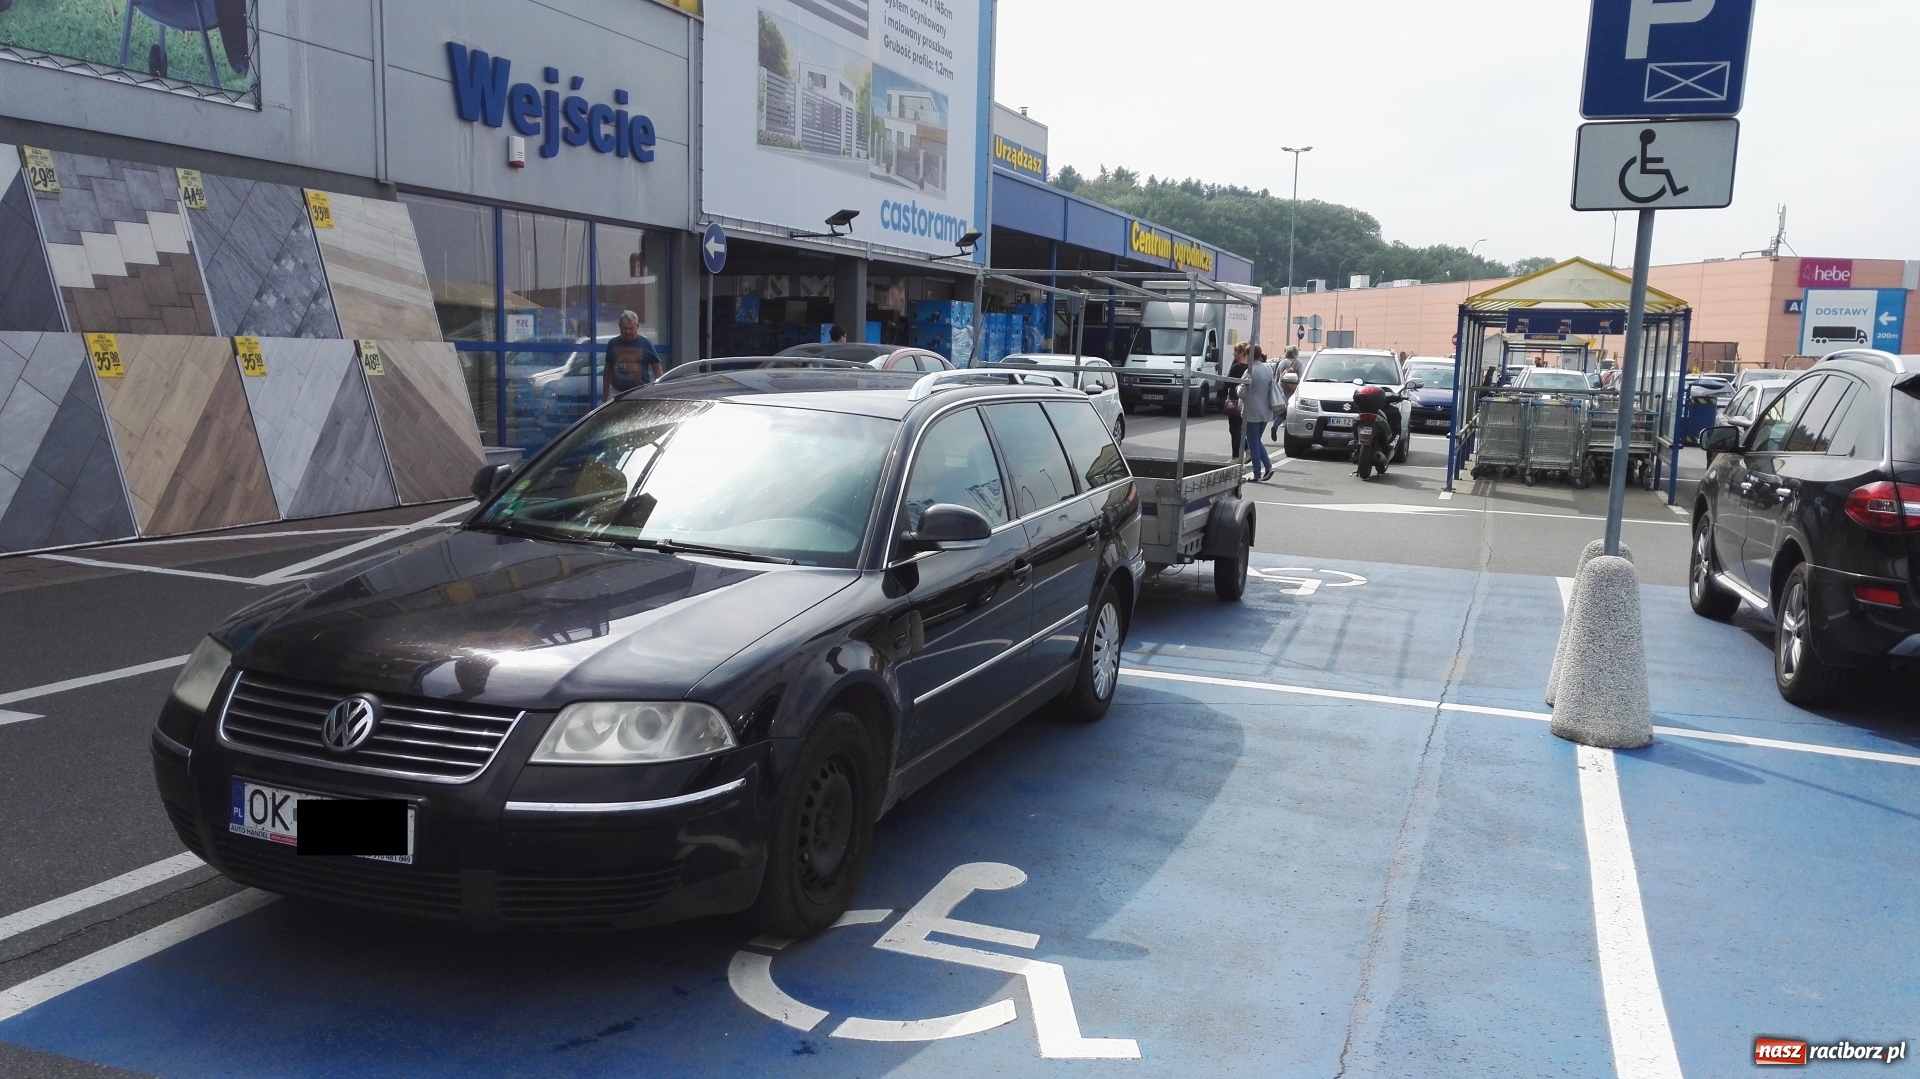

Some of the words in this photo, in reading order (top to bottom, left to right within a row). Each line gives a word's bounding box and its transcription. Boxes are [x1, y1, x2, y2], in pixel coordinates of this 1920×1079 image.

[910, 8, 946, 39] ocynkowany
[934, 0, 953, 21] 145cm
[1625, 0, 1717, 60] P
[884, 10, 887, 24] i
[888, 16, 922, 46] malowany
[922, 35, 953, 60] proszkowo
[883, 34, 911, 60] Grubość
[935, 60, 954, 81] 1,2mm
[446, 41, 655, 162] Wejście
[995, 136, 1042, 174] Urządzasz
[880, 199, 967, 244] castorama
[1131, 220, 1172, 260] Centrum
[1173, 241, 1214, 272] ogrodnicze
[1814, 265, 1851, 281] hebe
[1815, 307, 1869, 316] DOSTAWY
[233, 806, 243, 818] PL
[250, 788, 290, 831] OK
[230, 824, 246, 834] AUTO
[247, 828, 269, 840] HANDEL
